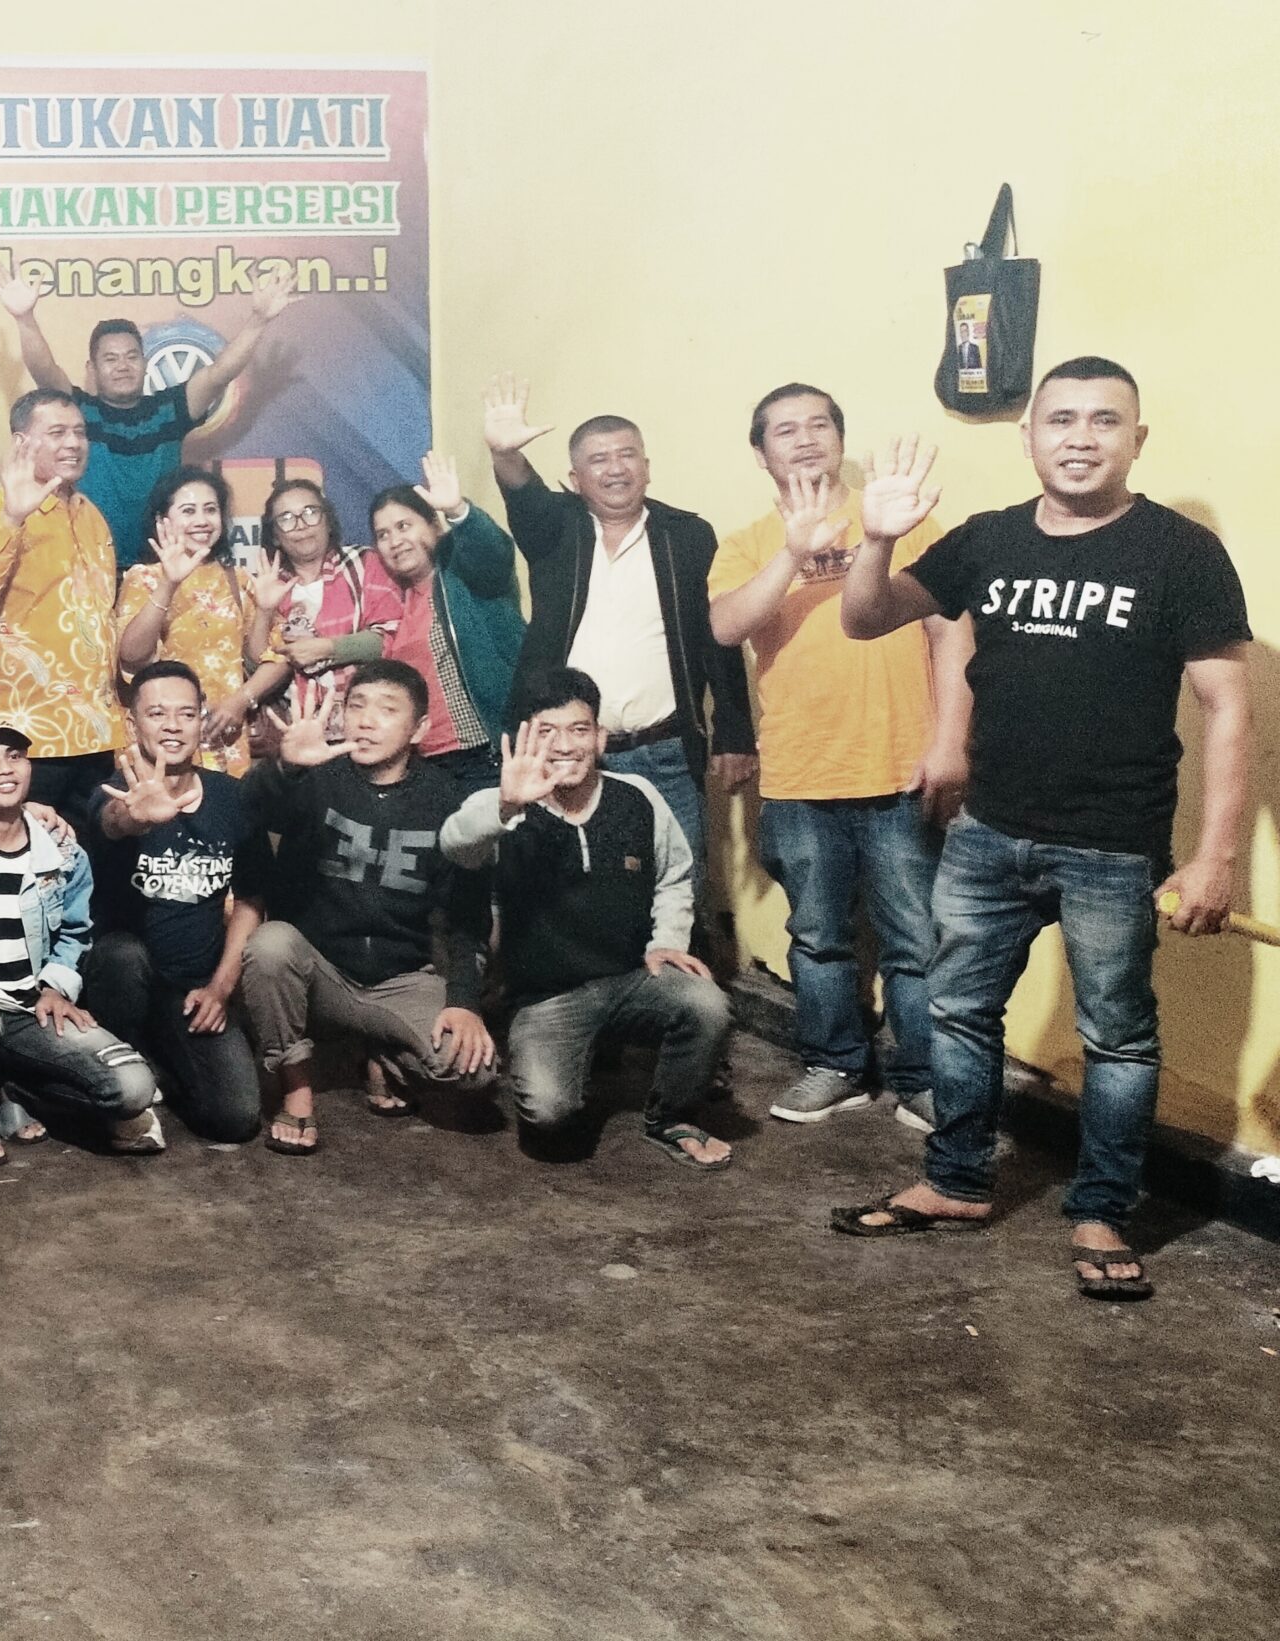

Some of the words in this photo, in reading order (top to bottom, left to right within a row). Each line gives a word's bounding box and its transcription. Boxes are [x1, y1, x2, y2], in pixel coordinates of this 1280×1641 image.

[239, 96, 390, 149] HATI
[175, 185, 396, 226] PERSEPSI
[981, 578, 1136, 628] STRIPE
[1011, 621, 1078, 638] 3-ORIGINAL
